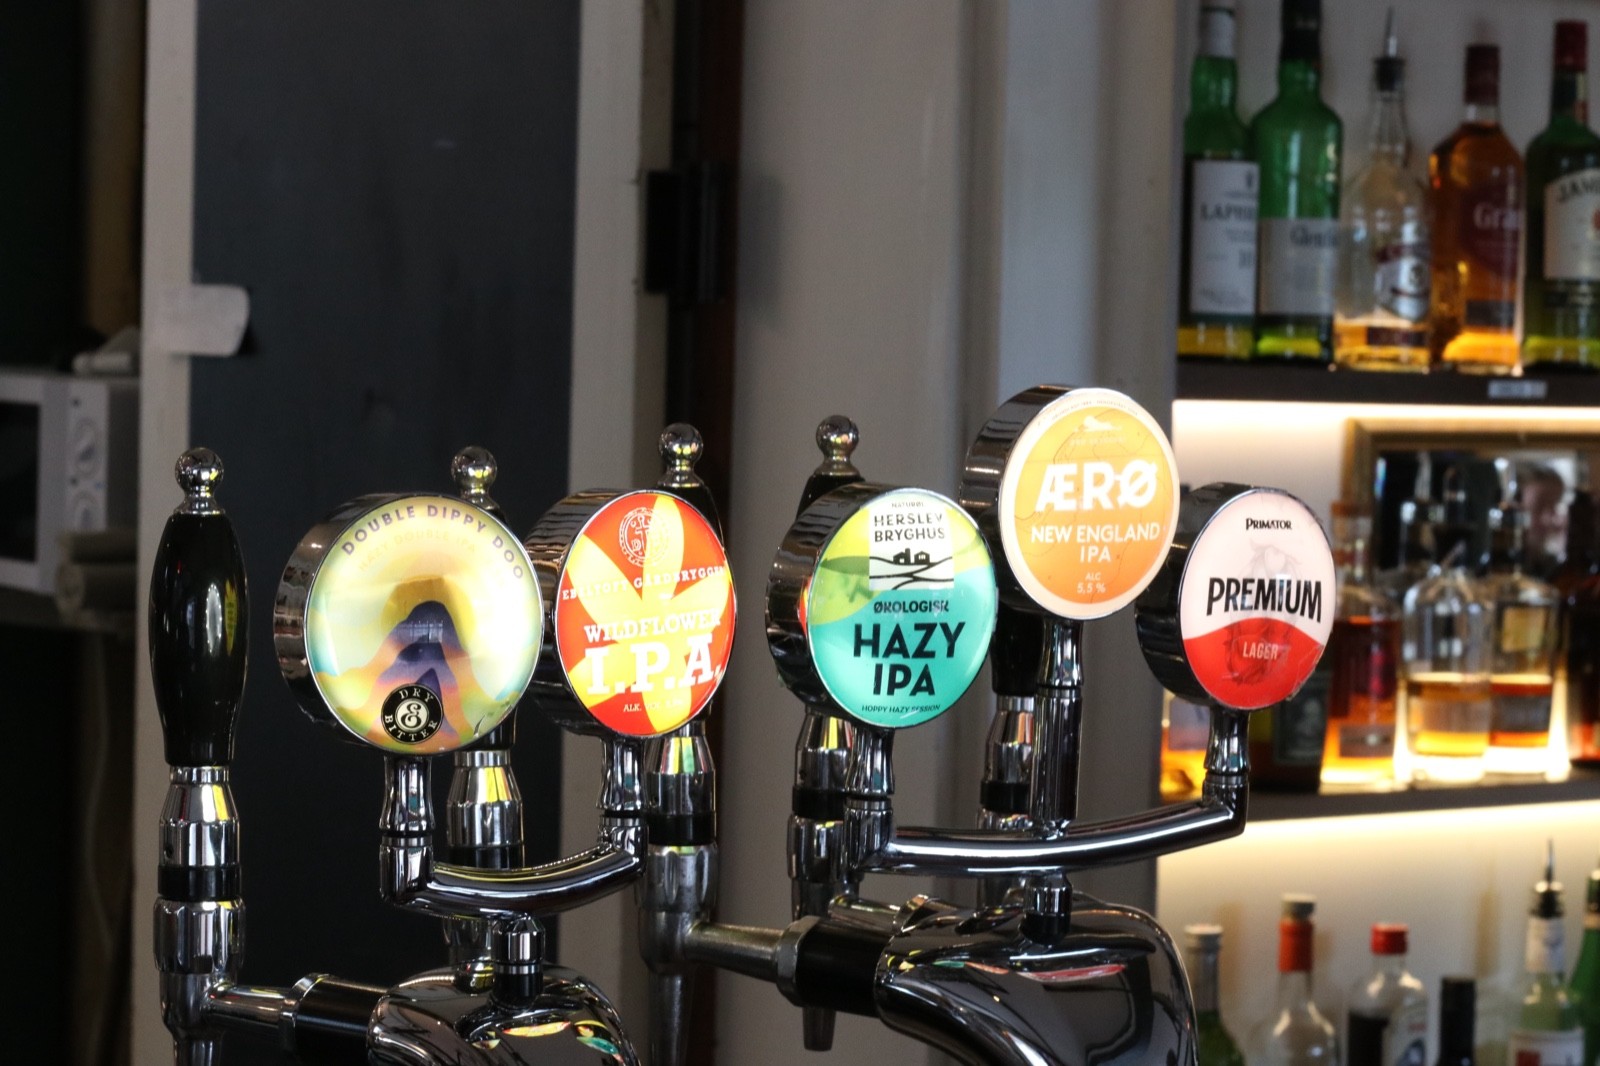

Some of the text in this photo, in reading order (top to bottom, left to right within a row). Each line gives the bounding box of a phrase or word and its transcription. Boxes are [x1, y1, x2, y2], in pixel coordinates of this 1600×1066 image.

[1035, 459, 1158, 512] ÆRØ
[874, 512, 944, 527] HERSLEV
[341, 504, 524, 579] DOUBLE DIPPY DOO
[874, 527, 946, 543] BRYGHUS
[1031, 521, 1161, 544] NEW ENGLAND
[1080, 544, 1111, 563] IPA
[1085, 571, 1102, 581] ALC
[1095, 582, 1106, 593] %
[1206, 577, 1322, 623] PREMIUM
[584, 609, 721, 643] WILDFLOWER
[853, 621, 966, 659] HAZY
[1242, 641, 1278, 660] LAGER
[872, 662, 936, 697] IPA
[399, 687, 434, 702] DRY
[400, 702, 422, 729] &
[861, 704, 941, 714] HOPPY HAZY SESSION
[384, 714, 438, 741] BITTER
